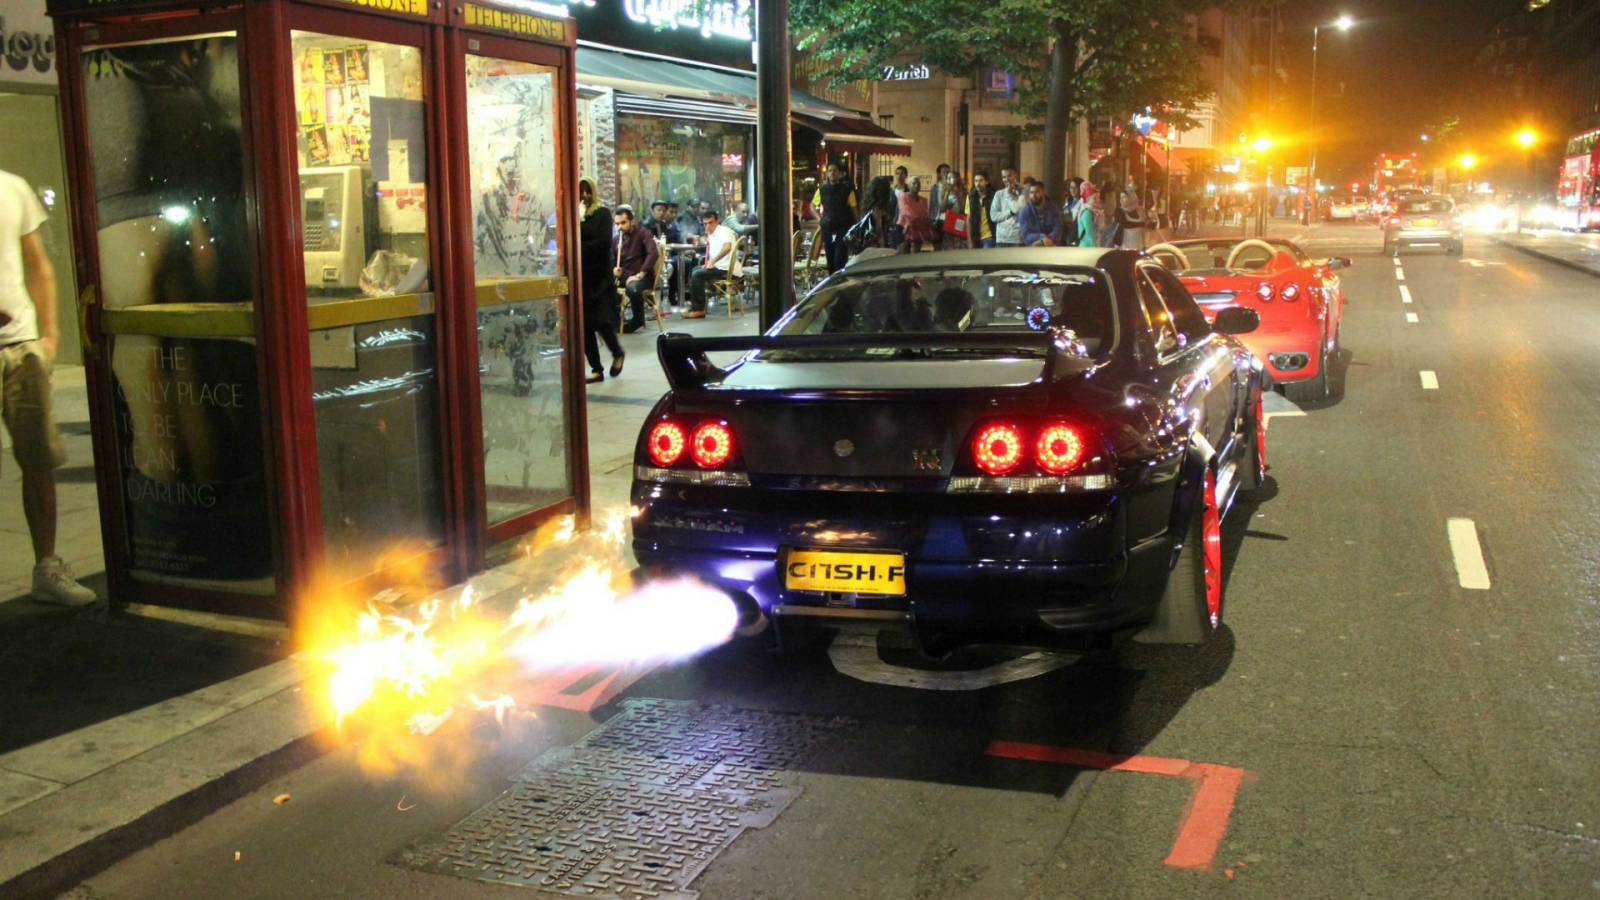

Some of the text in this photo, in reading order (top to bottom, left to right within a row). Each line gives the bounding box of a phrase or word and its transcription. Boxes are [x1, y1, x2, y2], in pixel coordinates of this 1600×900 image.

[470, 6, 558, 38] TELEPHONE
[152, 346, 187, 371] THE
[117, 380, 244, 408] ONLY PLACE
[120, 412, 177, 439] TO BE
[127, 477, 216, 508] DARLING
[679, 752, 727, 787] WIRELESS
[545, 787, 599, 825] WIRELESS
[541, 843, 597, 886] CABLE &
[556, 843, 618, 888] WIRELESS
